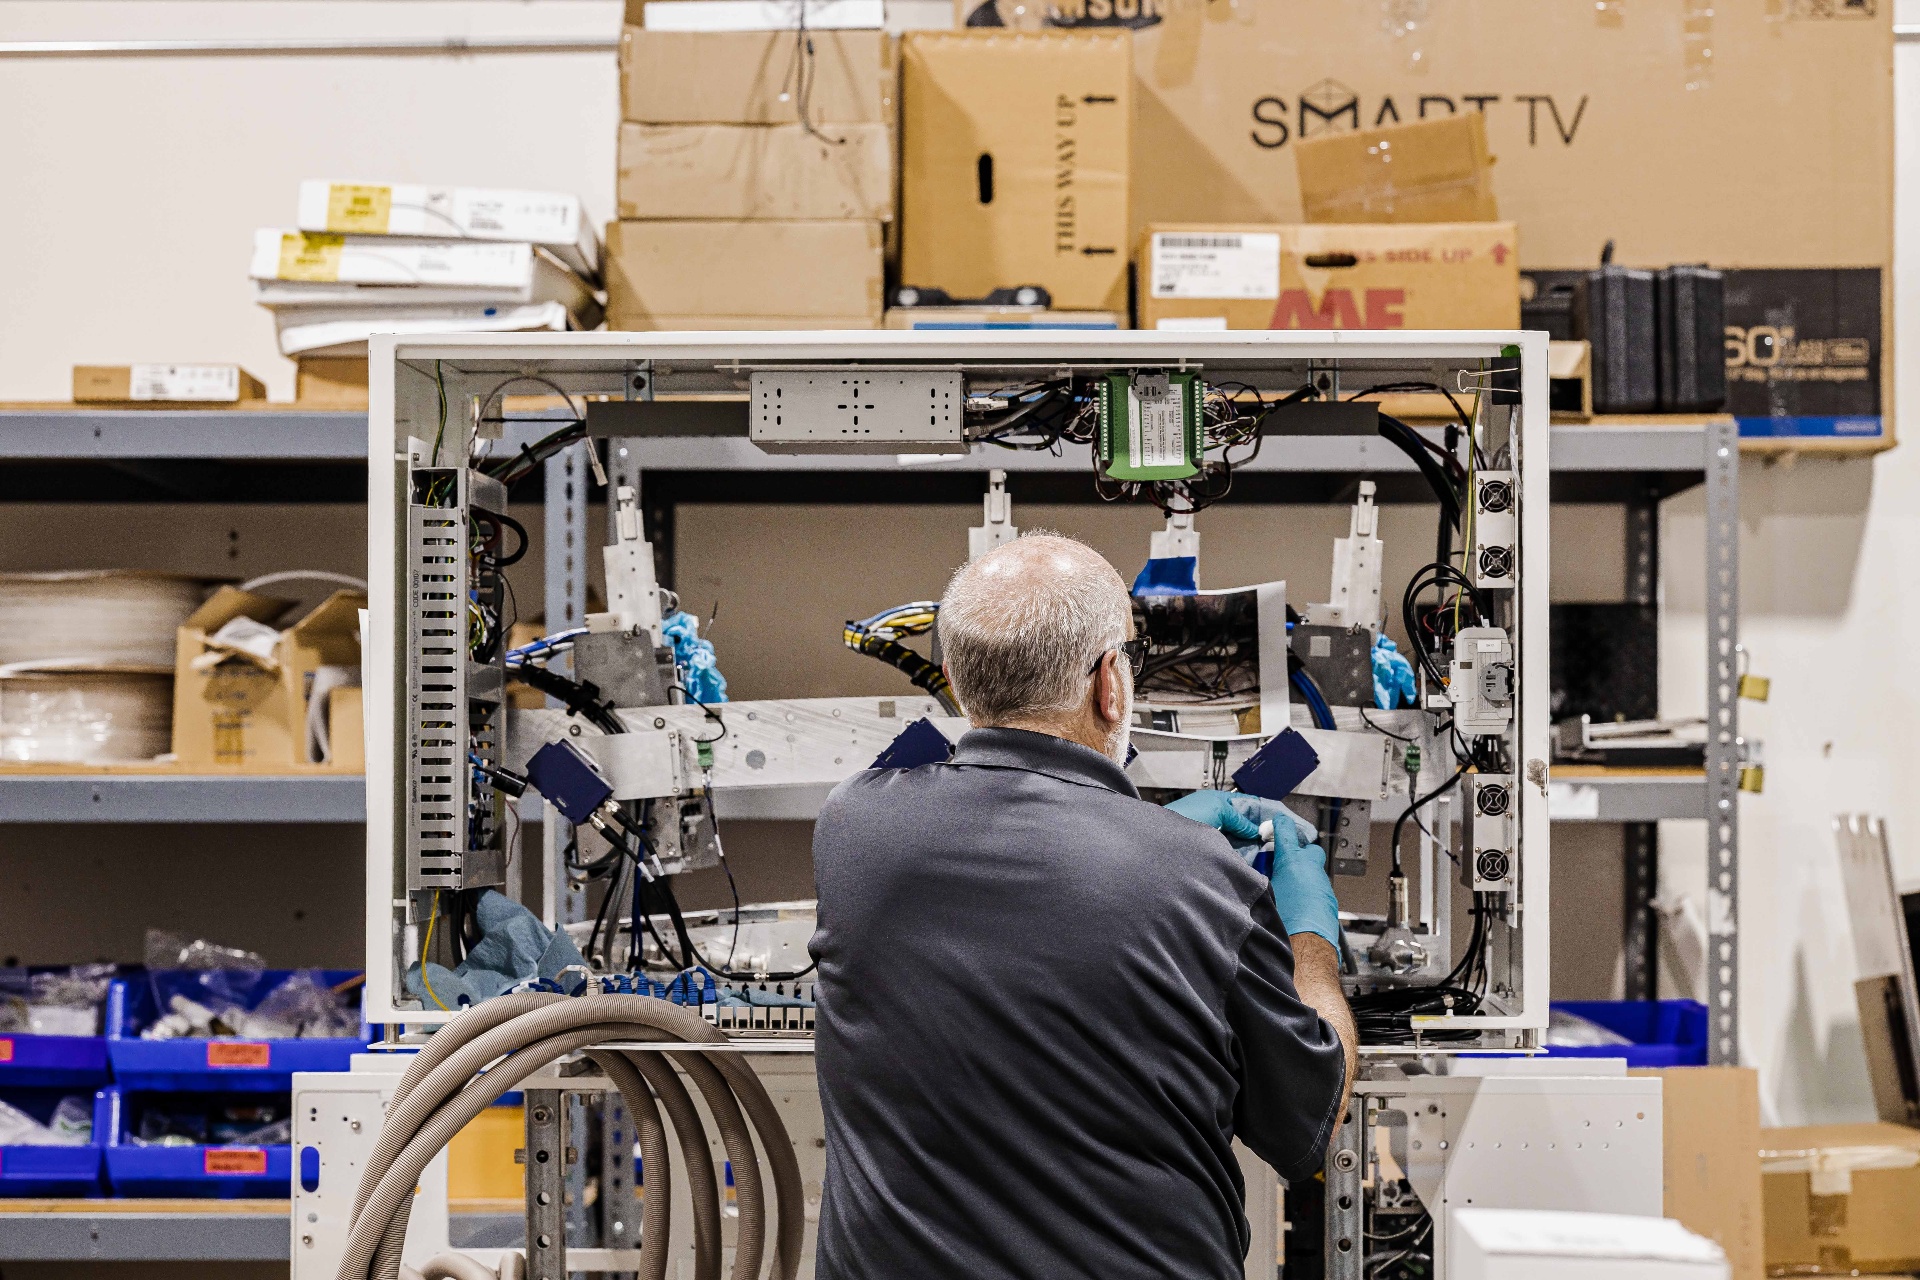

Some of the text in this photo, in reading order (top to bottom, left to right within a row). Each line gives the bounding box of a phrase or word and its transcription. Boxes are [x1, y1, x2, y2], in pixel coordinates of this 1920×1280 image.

[1513, 95, 1589, 145] TV
[1054, 94, 1076, 257] THIS WAY UP
[1441, 248, 1474, 264] UP
